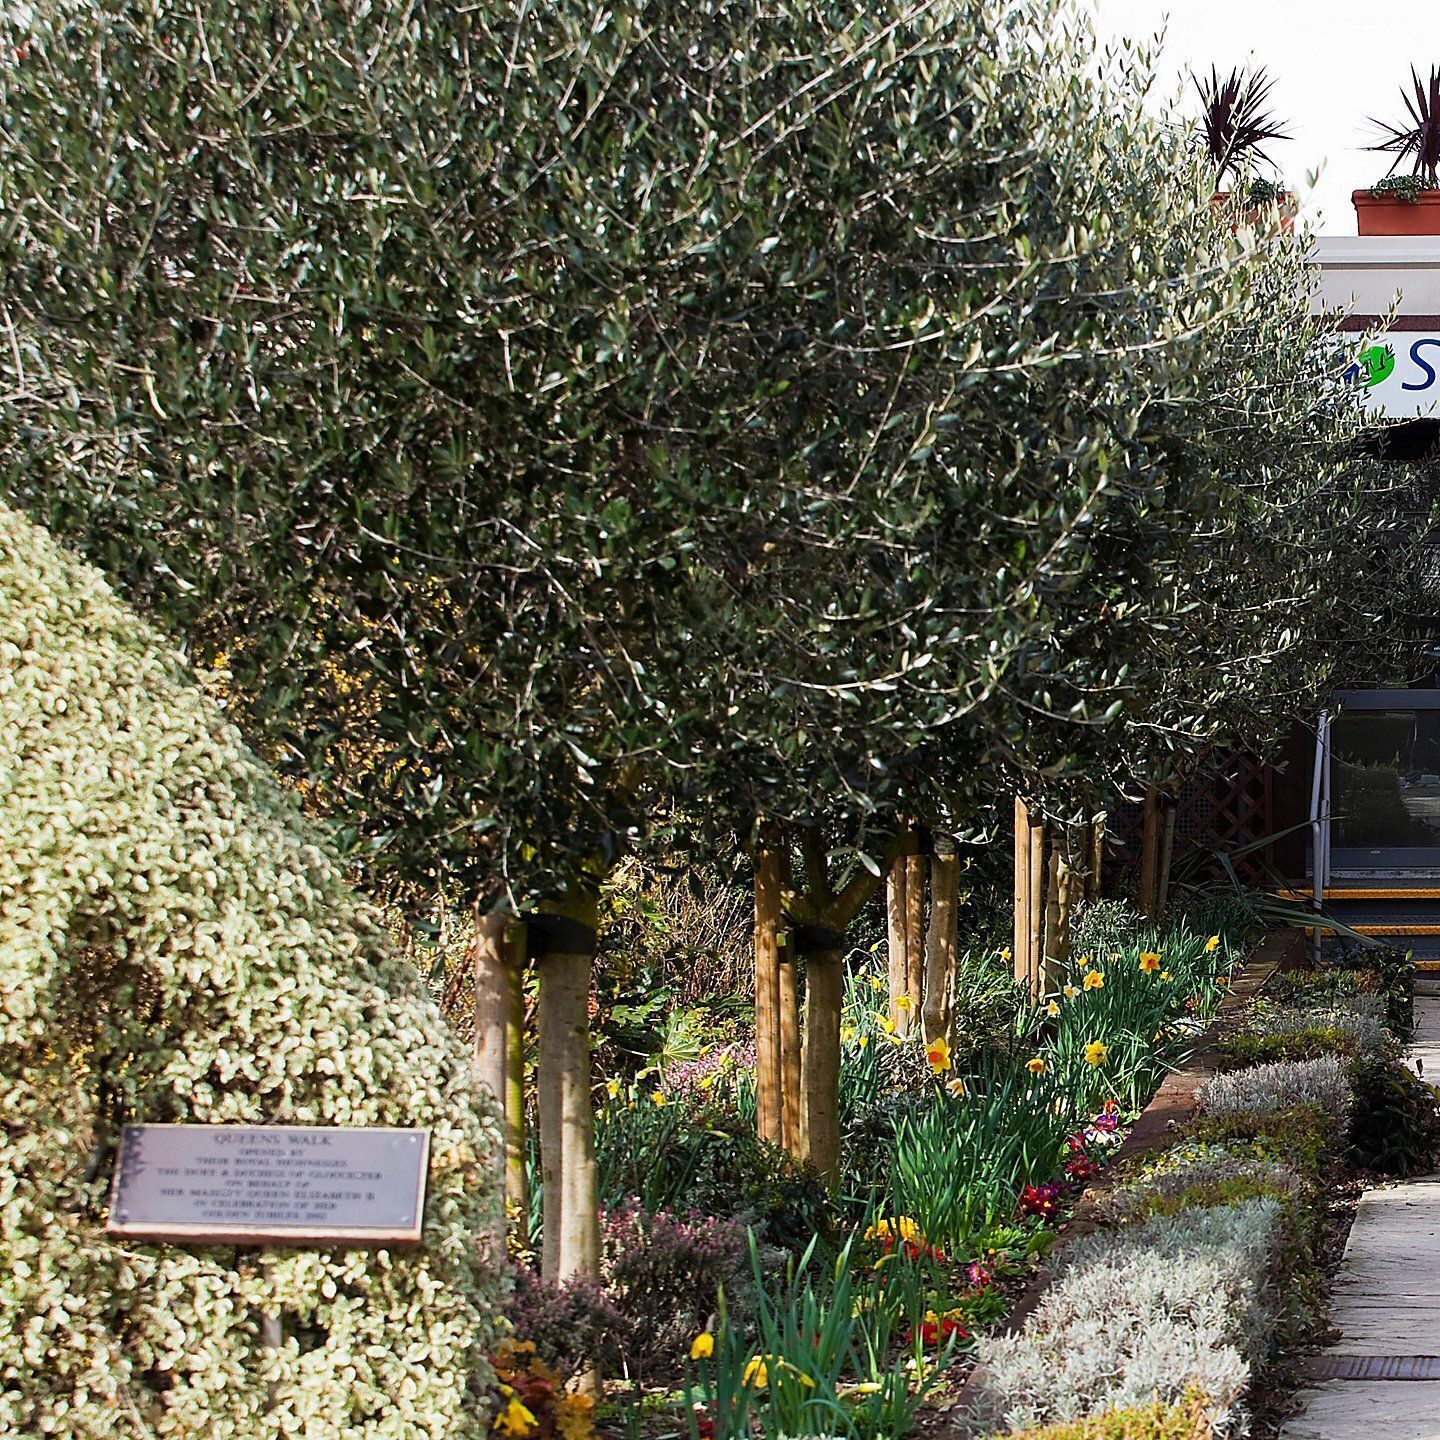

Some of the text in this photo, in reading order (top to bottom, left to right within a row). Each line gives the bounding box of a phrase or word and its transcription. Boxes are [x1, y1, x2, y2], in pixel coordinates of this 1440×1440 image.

[213, 1133, 332, 1146] QUEENS WALK
[235, 1157, 270, 1166] ROYAL
[289, 1170, 304, 1178] OF
[294, 1181, 310, 1189] OF
